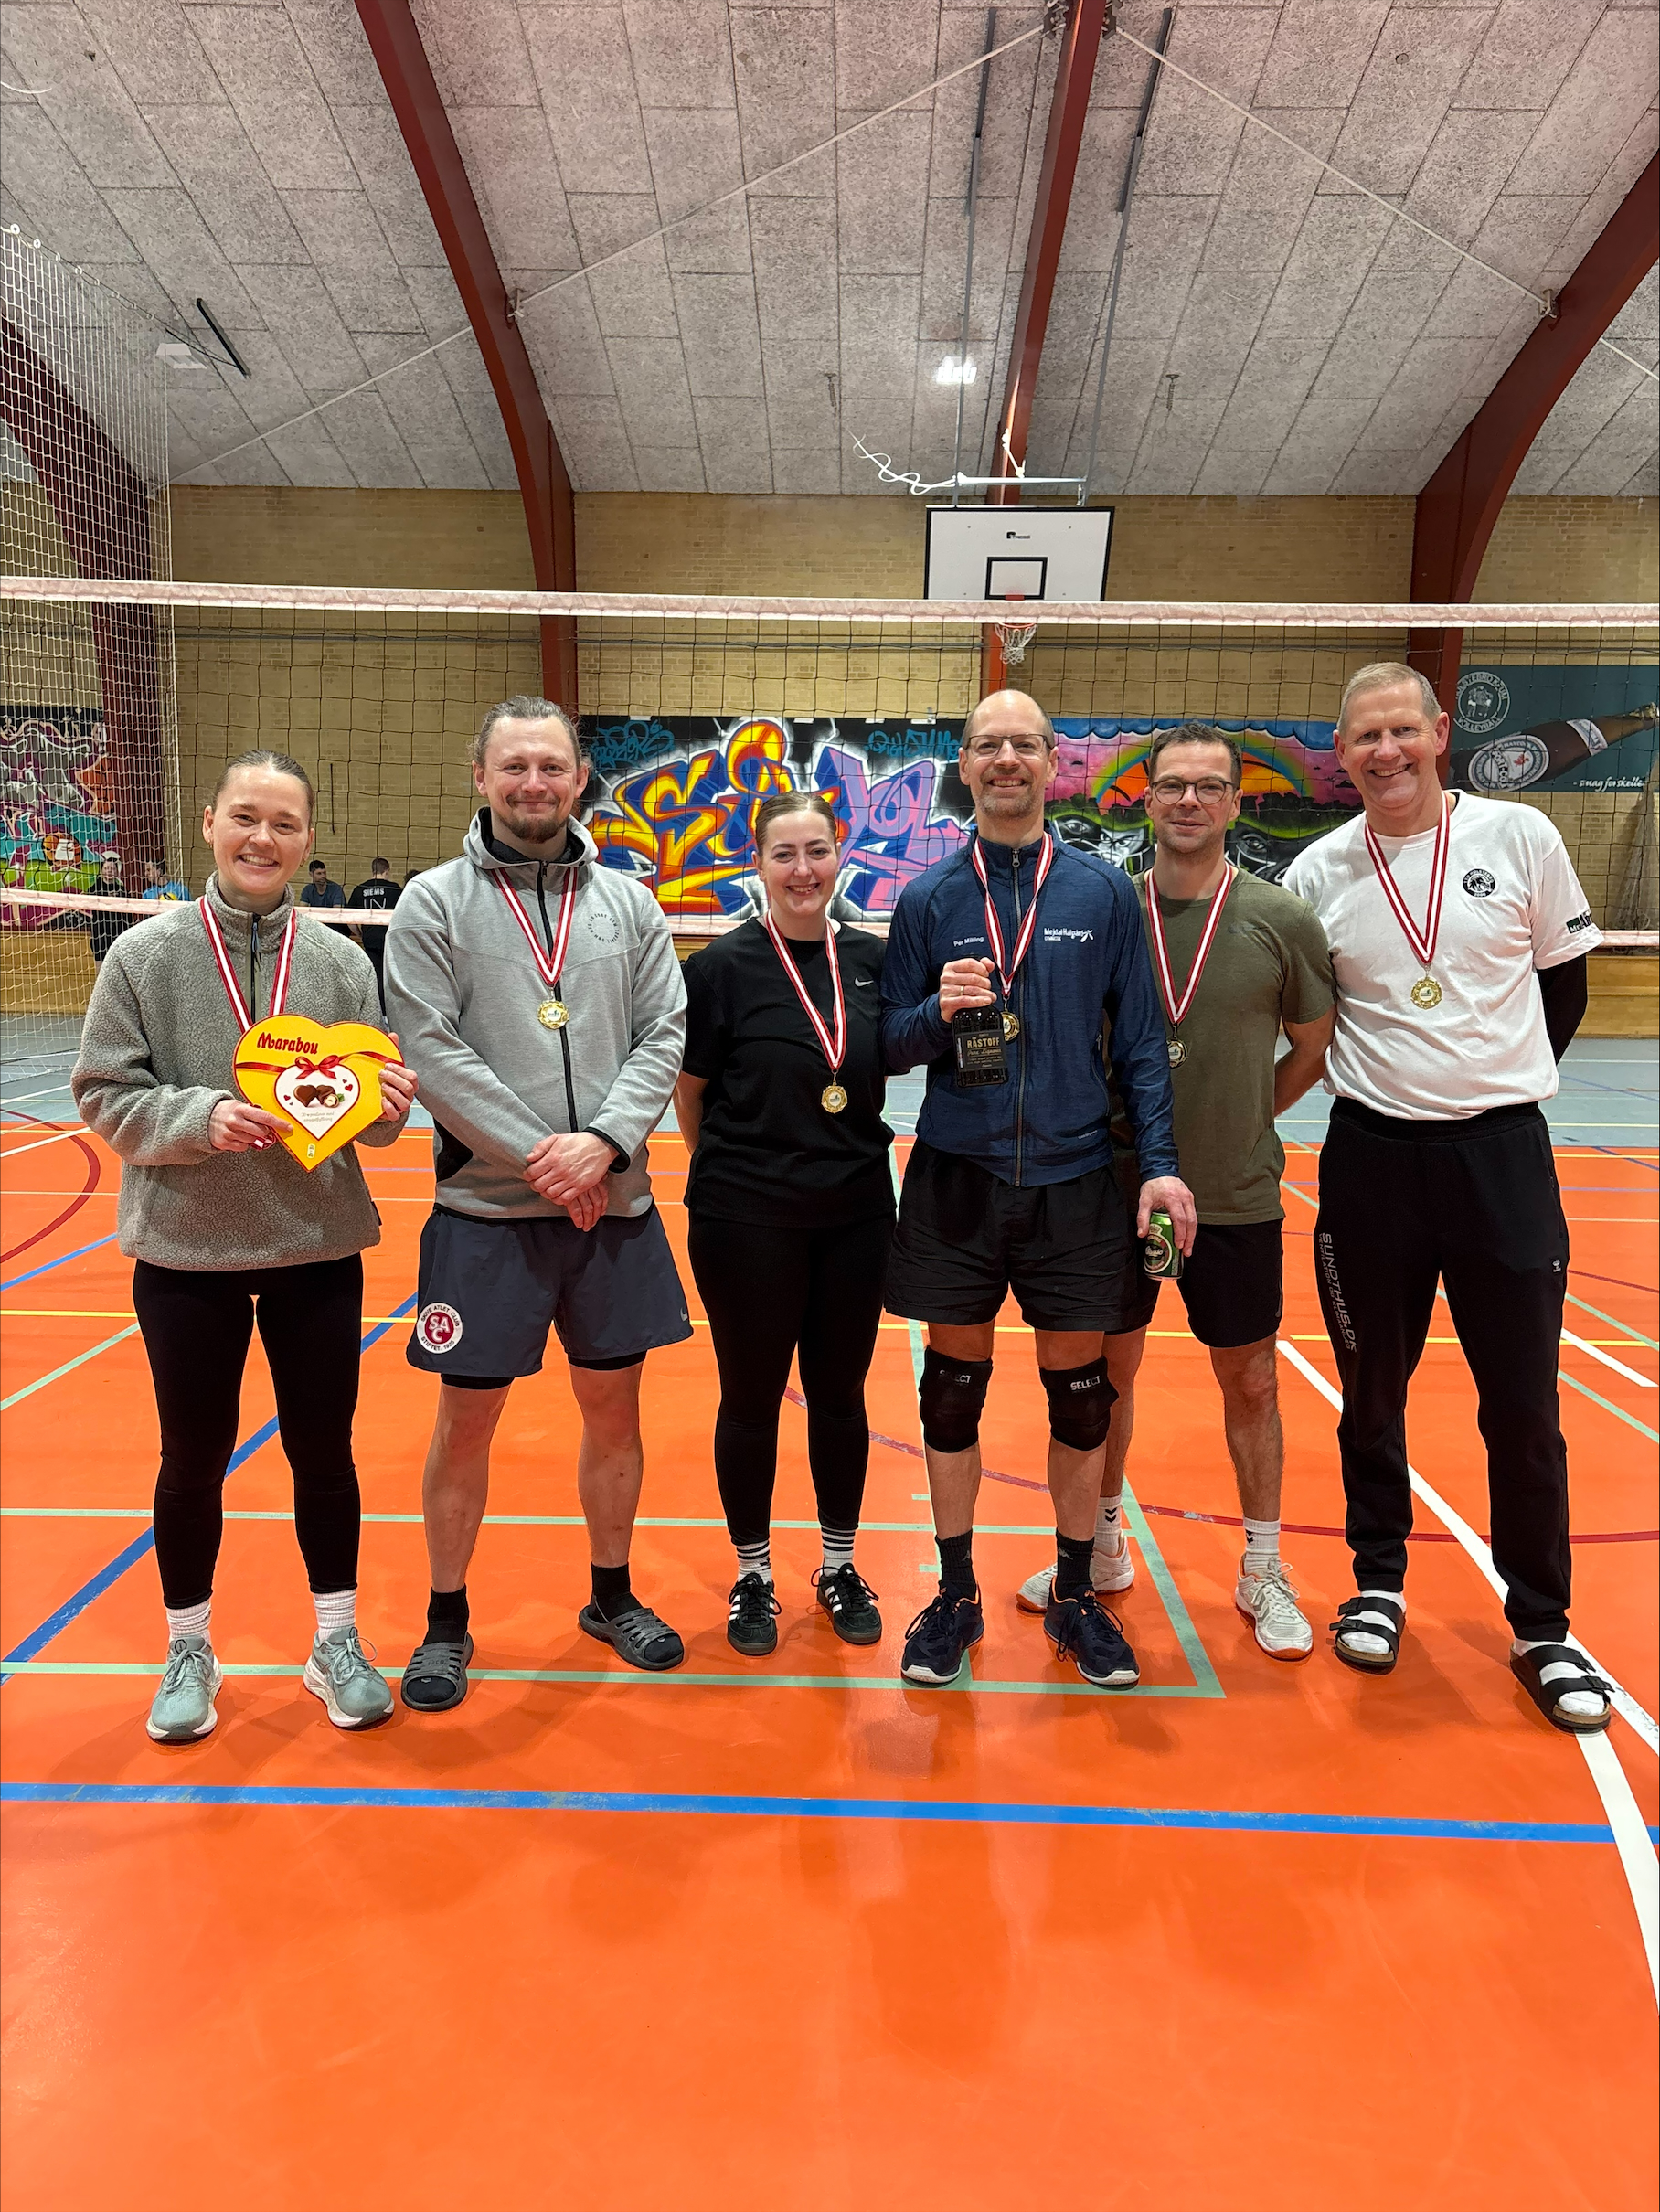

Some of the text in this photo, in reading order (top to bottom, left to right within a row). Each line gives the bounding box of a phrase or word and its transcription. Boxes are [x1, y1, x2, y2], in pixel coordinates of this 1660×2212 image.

[363, 888, 385, 897] SIEMS
[257, 1032, 318, 1054] Marabou
[966, 1036, 1000, 1048] RÅSTOFF
[1322, 1232, 1357, 1353] SUNDTHUS.DK
[420, 1307, 432, 1322] SKIVE
[451, 1313, 460, 1327] CLUB
[1069, 1375, 1101, 1391] SELECT
